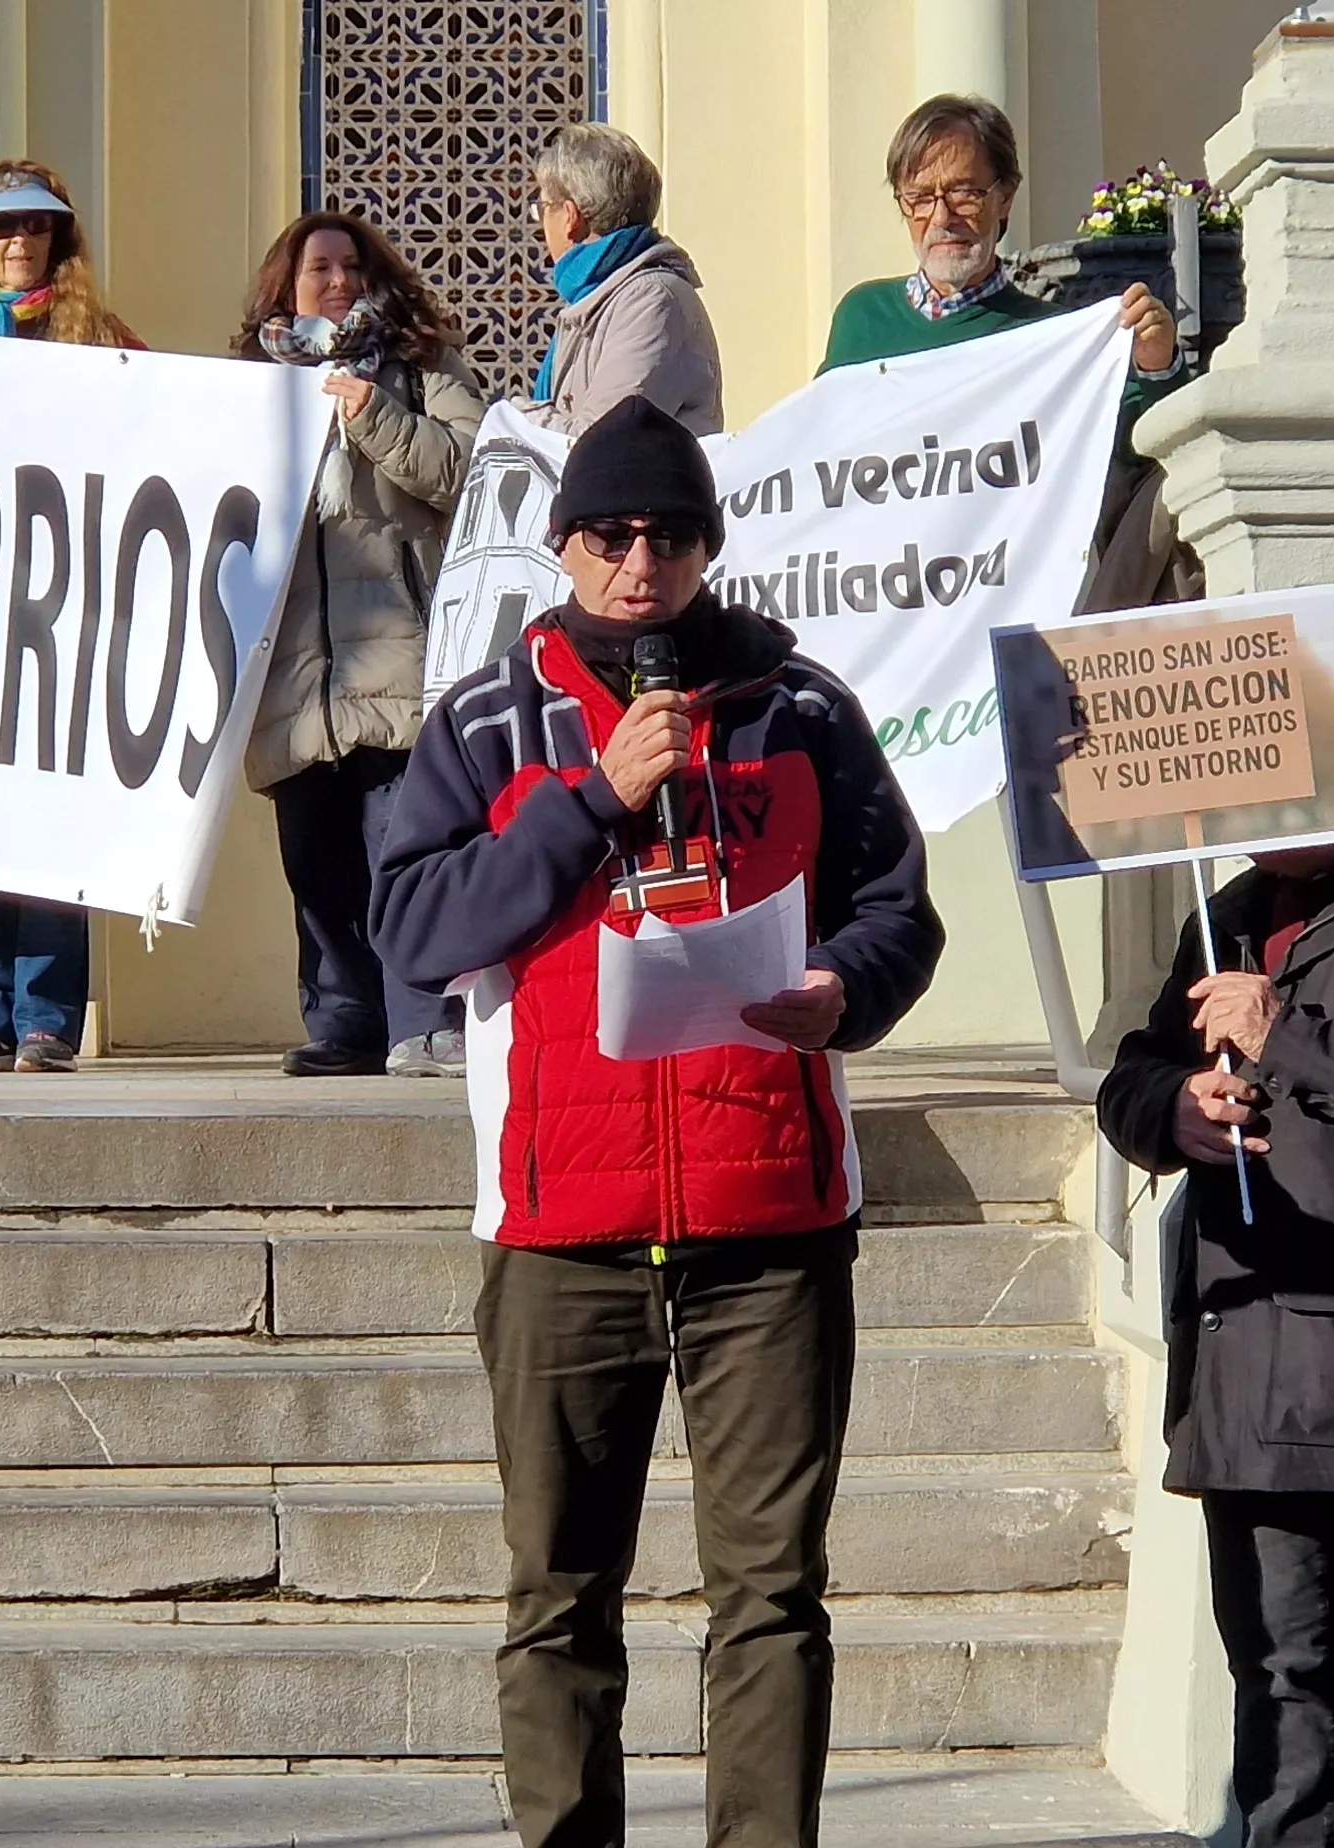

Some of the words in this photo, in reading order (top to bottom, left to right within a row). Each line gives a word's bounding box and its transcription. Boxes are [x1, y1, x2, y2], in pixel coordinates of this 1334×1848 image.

[814, 420, 1041, 508] vecinal
[1063, 647, 1155, 683] BARRIO
[1163, 640, 1214, 672] SAN
[1220, 630, 1289, 664] JOSE:
[1068, 667, 1292, 727] RENOVACION
[1073, 723, 1190, 760] ESTANQUE
[1195, 717, 1224, 744] DE
[1228, 708, 1298, 741] PATOS
[1091, 764, 1110, 792] Y
[1117, 759, 1151, 789] SU
[1159, 743, 1282, 784] ENTORNO
